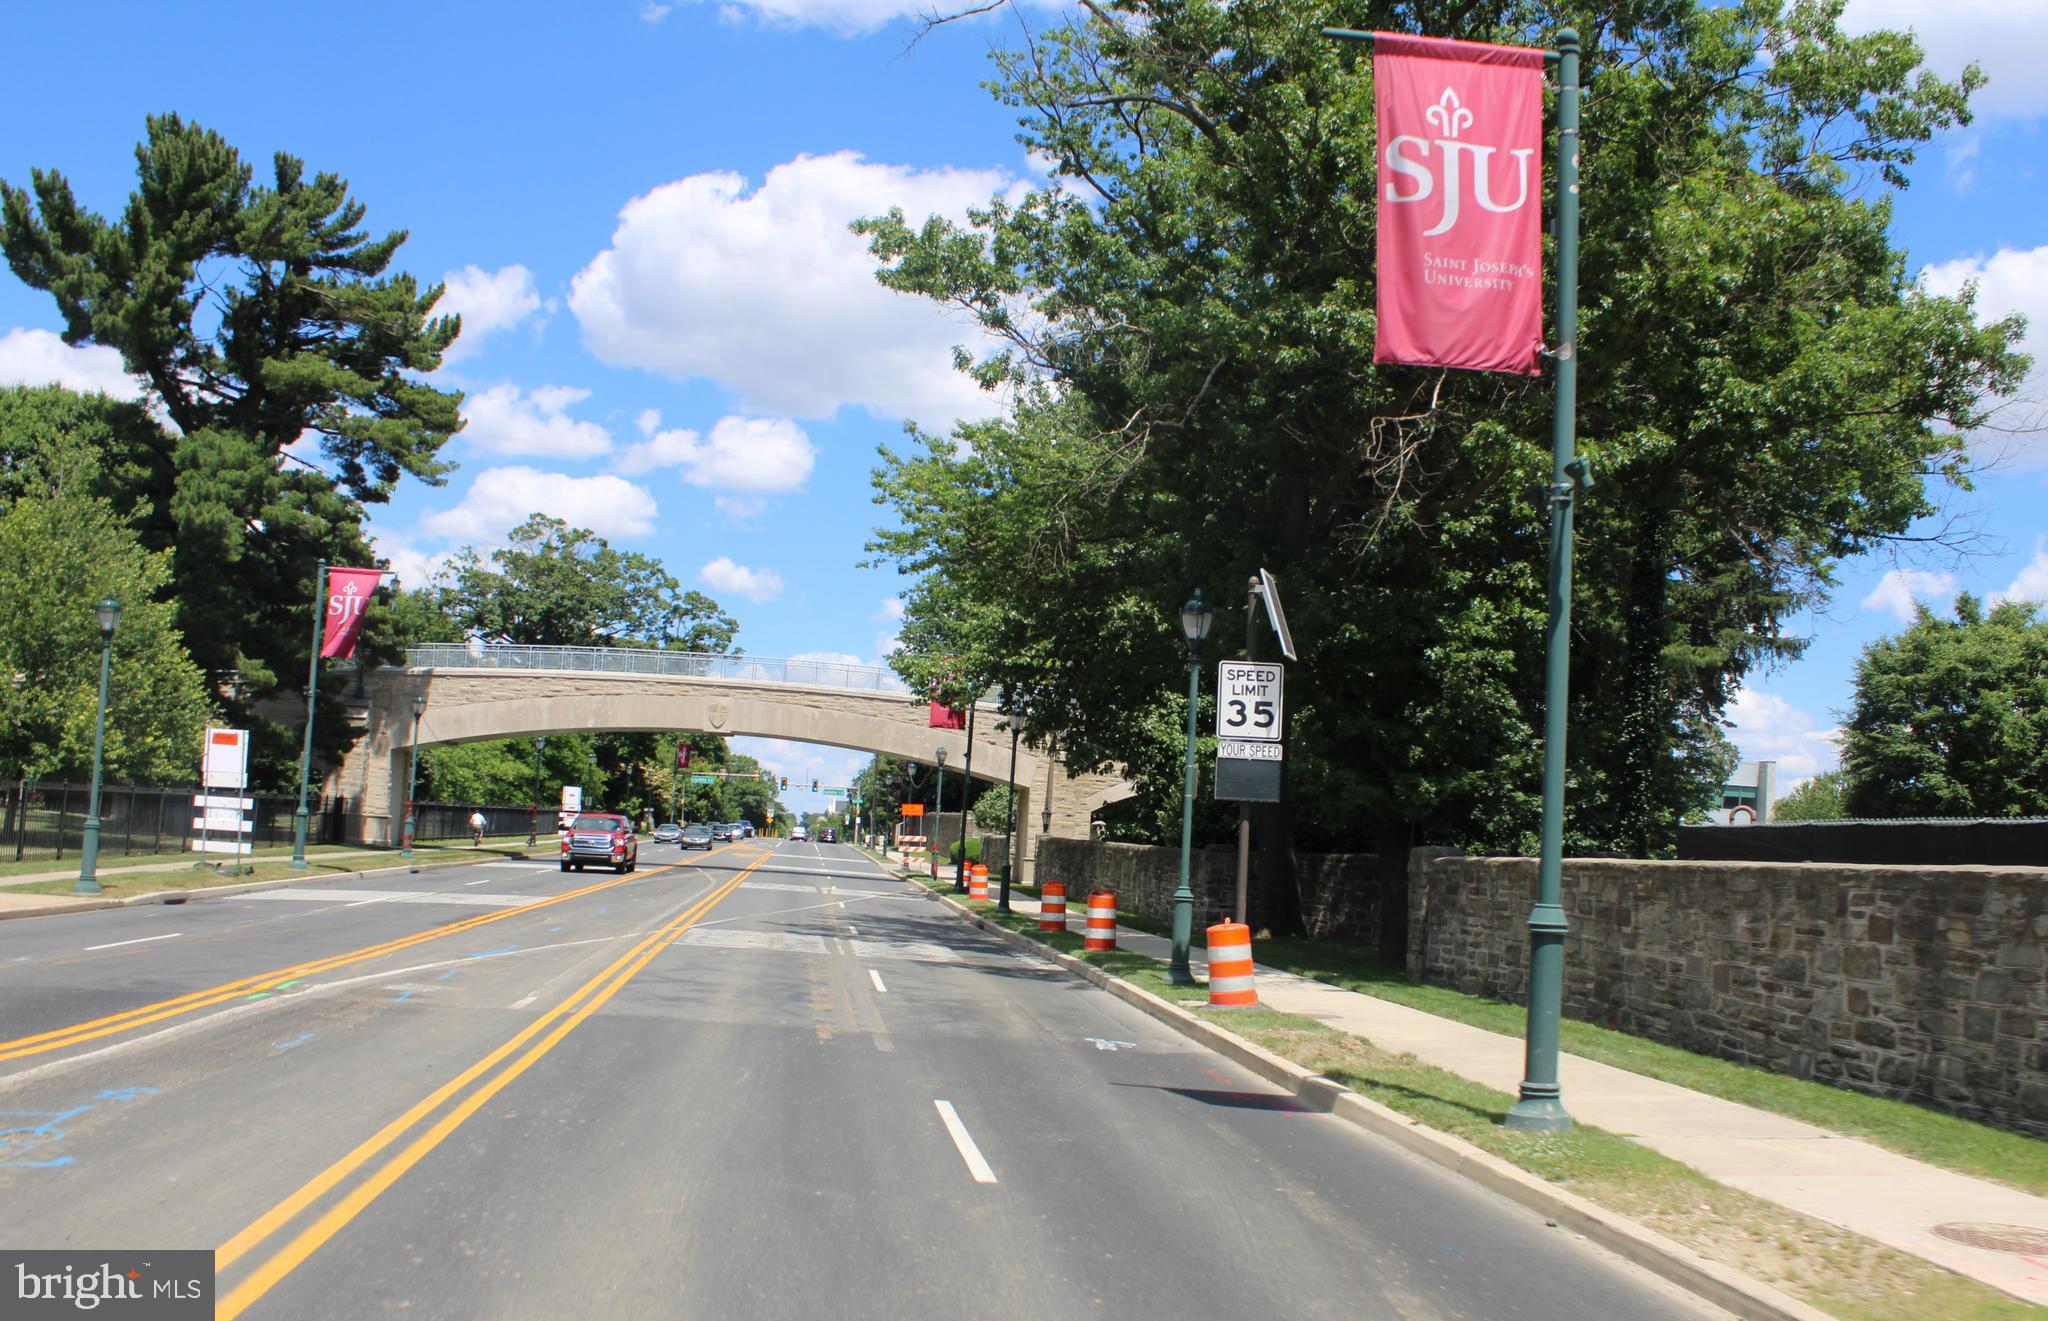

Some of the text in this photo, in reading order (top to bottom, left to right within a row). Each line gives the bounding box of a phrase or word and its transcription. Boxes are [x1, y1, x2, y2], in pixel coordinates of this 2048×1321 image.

[1385, 134, 1534, 236] SJU
[1227, 669, 1276, 682] SPEED
[1232, 685, 1269, 697] LIMIT
[1226, 699, 1275, 728] 35
[1220, 743, 1280, 758] YOUR SPEED
